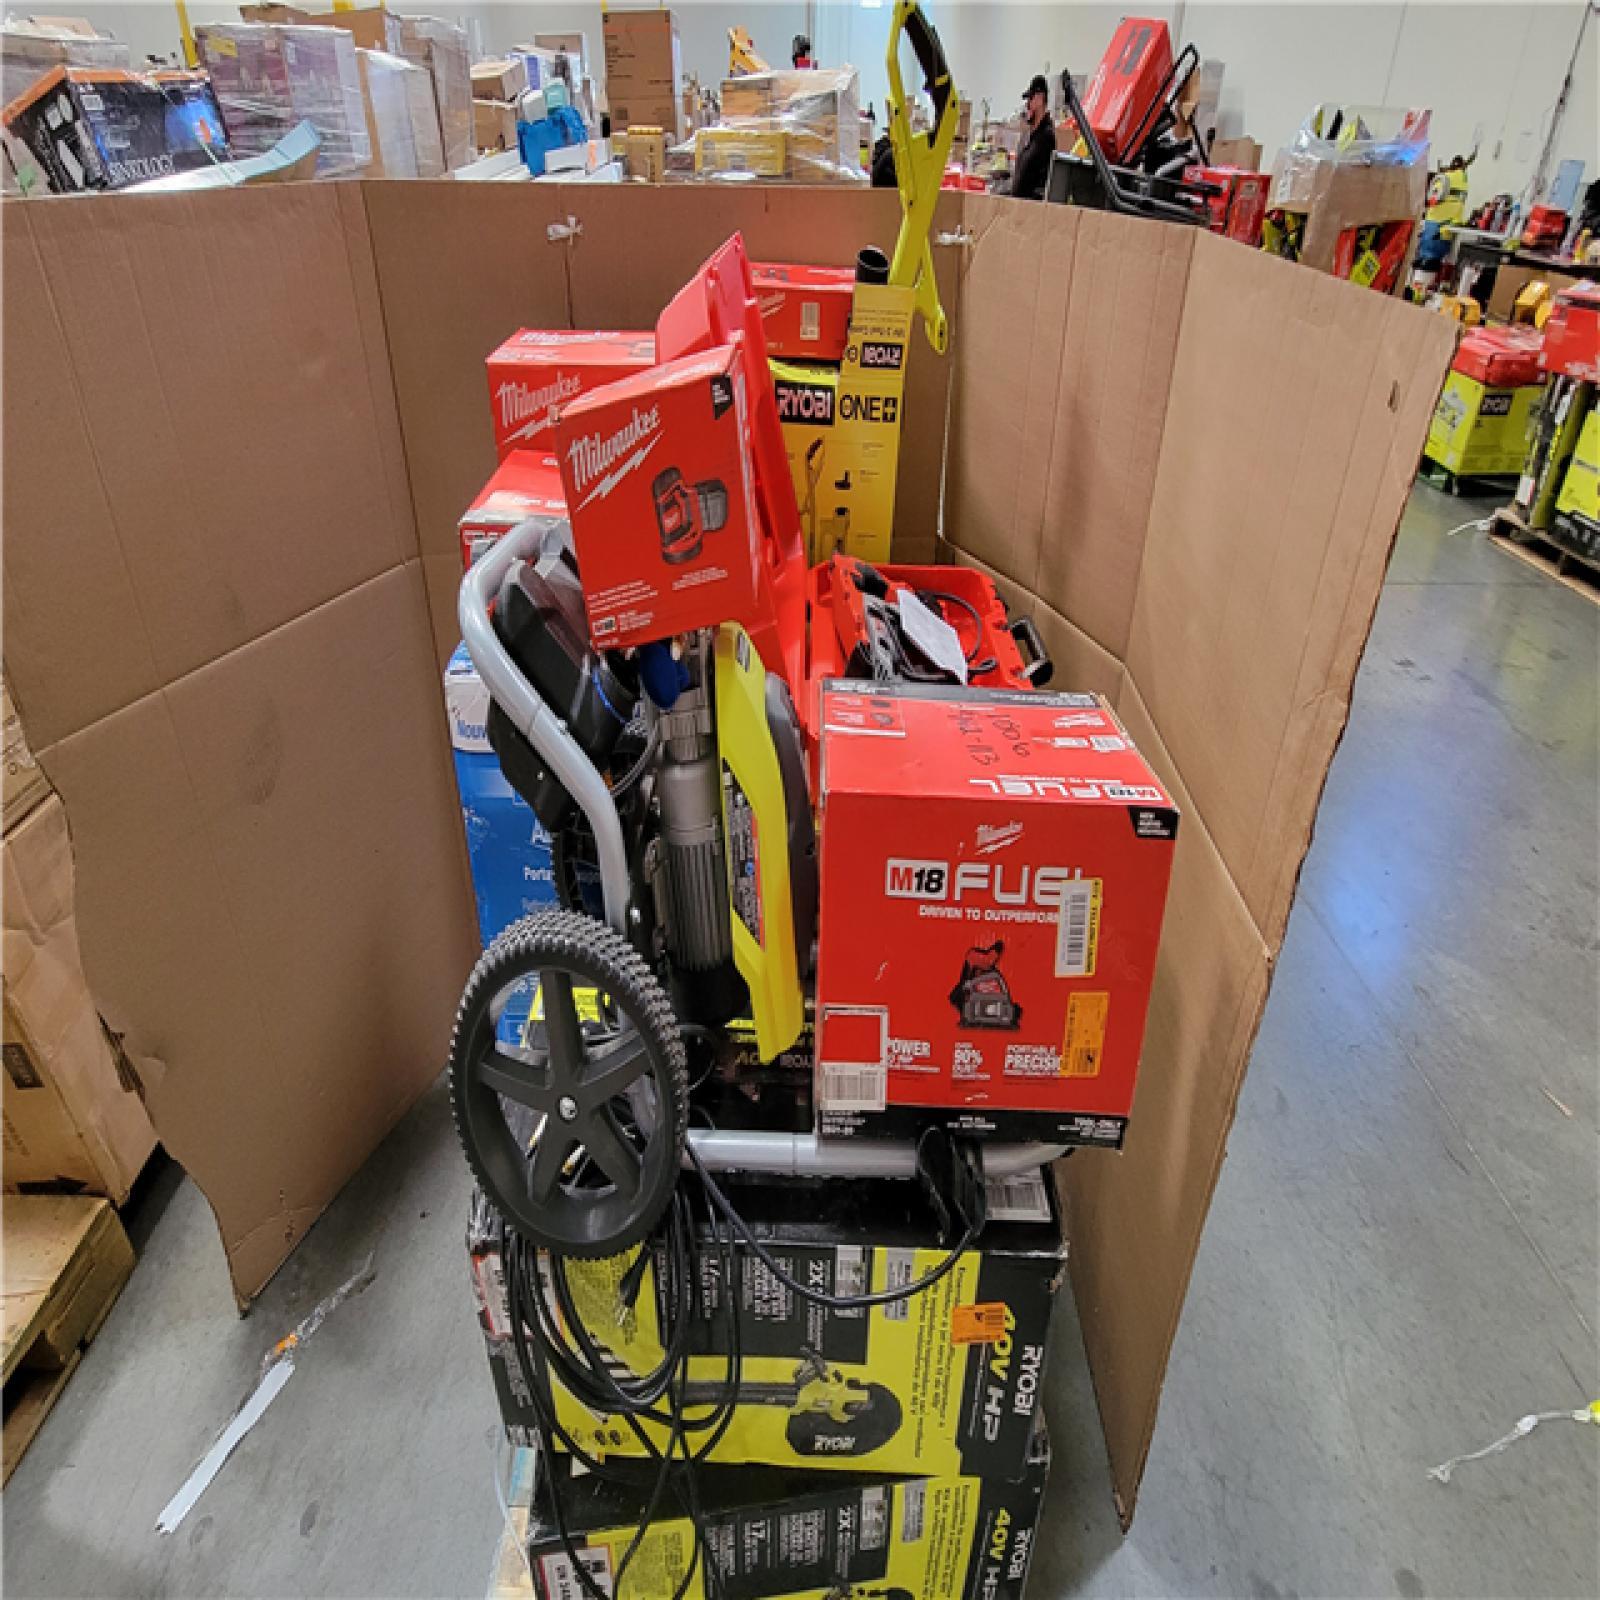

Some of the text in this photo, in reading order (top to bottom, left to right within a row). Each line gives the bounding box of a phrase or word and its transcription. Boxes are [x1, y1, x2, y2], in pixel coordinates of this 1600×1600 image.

[863, 345, 901, 364] RYOBI
[494, 370, 582, 429] Milwaukee
[777, 386, 833, 421] RYOBI
[840, 394, 898, 424] ONE+
[563, 403, 661, 493] Milwaukee
[969, 776, 1103, 799] FUEL
[889, 864, 1100, 906] M18 FUE
[919, 904, 963, 919] DRIVEN
[965, 908, 981, 921] TO
[1013, 1345, 1044, 1416] RYOBI
[983, 1385, 1005, 1442] HP
[989, 1507, 1011, 1561] 40V
[1007, 1527, 1032, 1579] RYOBI
